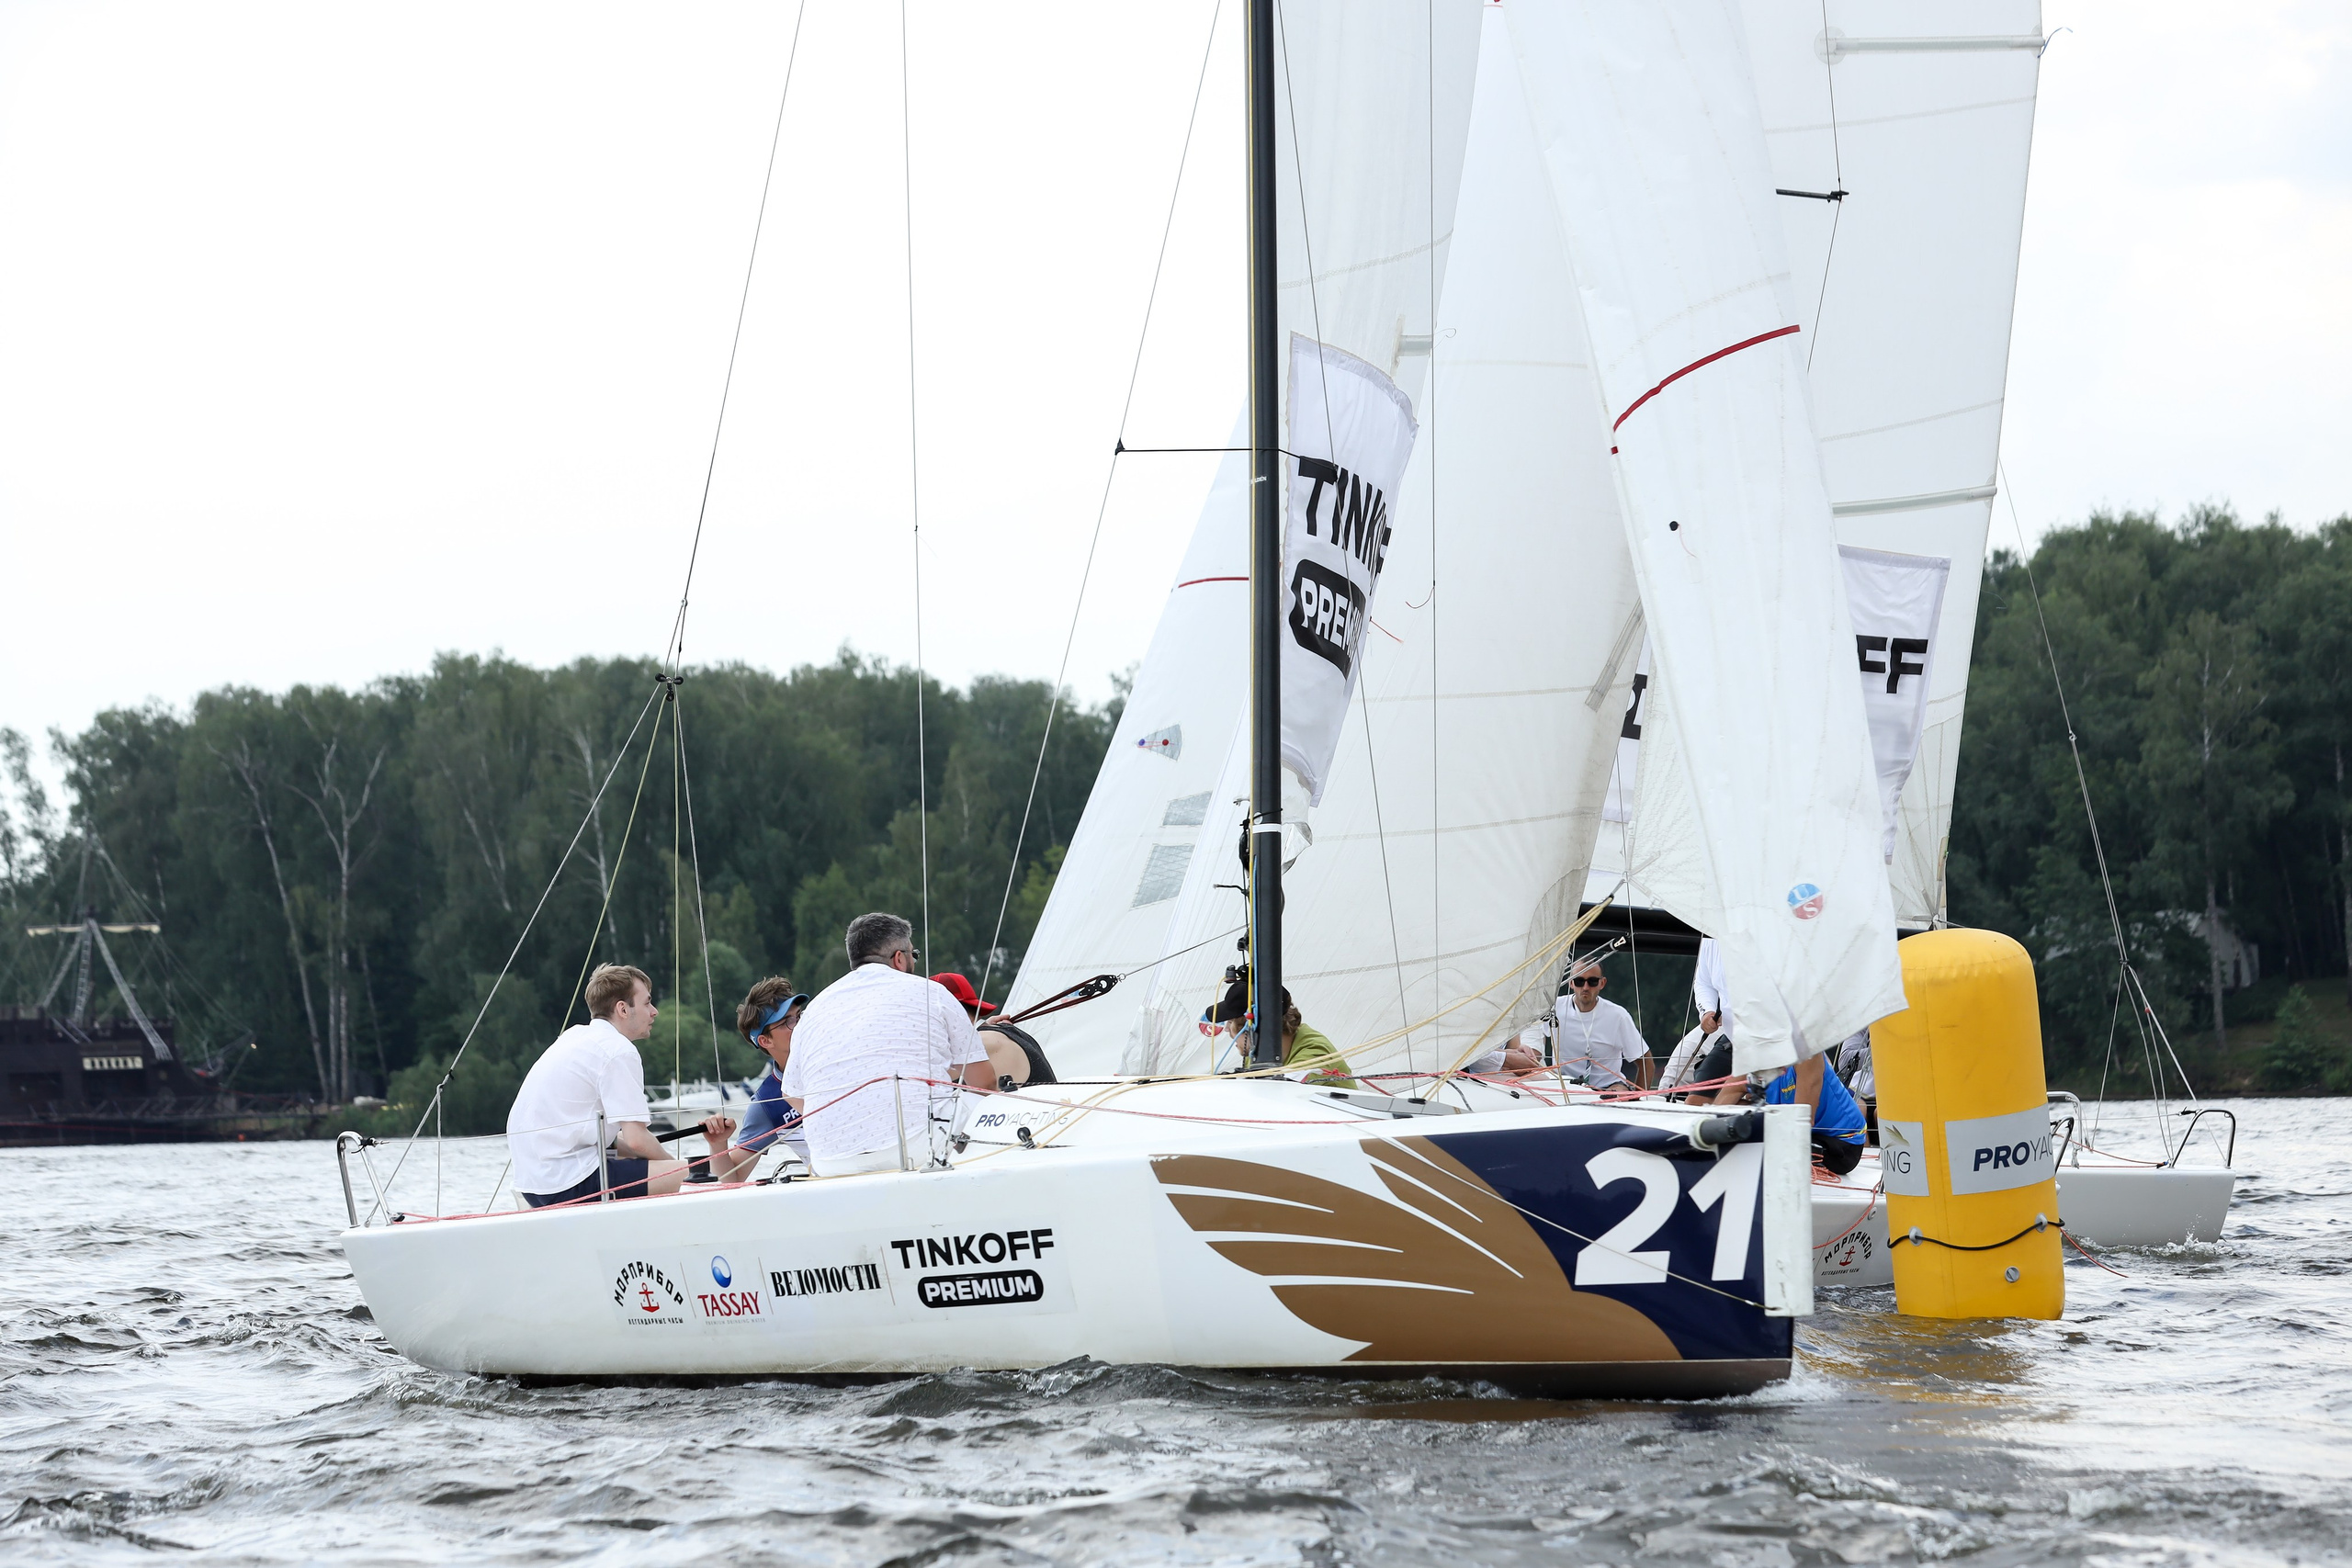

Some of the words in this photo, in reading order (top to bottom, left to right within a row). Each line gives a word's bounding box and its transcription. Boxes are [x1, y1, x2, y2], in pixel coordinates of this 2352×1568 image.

[975, 1111, 1069, 1128] PROYACHTING
[1574, 1142, 1765, 1285] 21
[890, 1228, 1055, 1269] TINKOFF
[614, 1260, 684, 1307] МОРПРИБОР
[770, 1263, 882, 1299] ВЕДОМОСТИ
[923, 1275, 1036, 1303] PREMIUM
[697, 1292, 761, 1317] TASSAY
